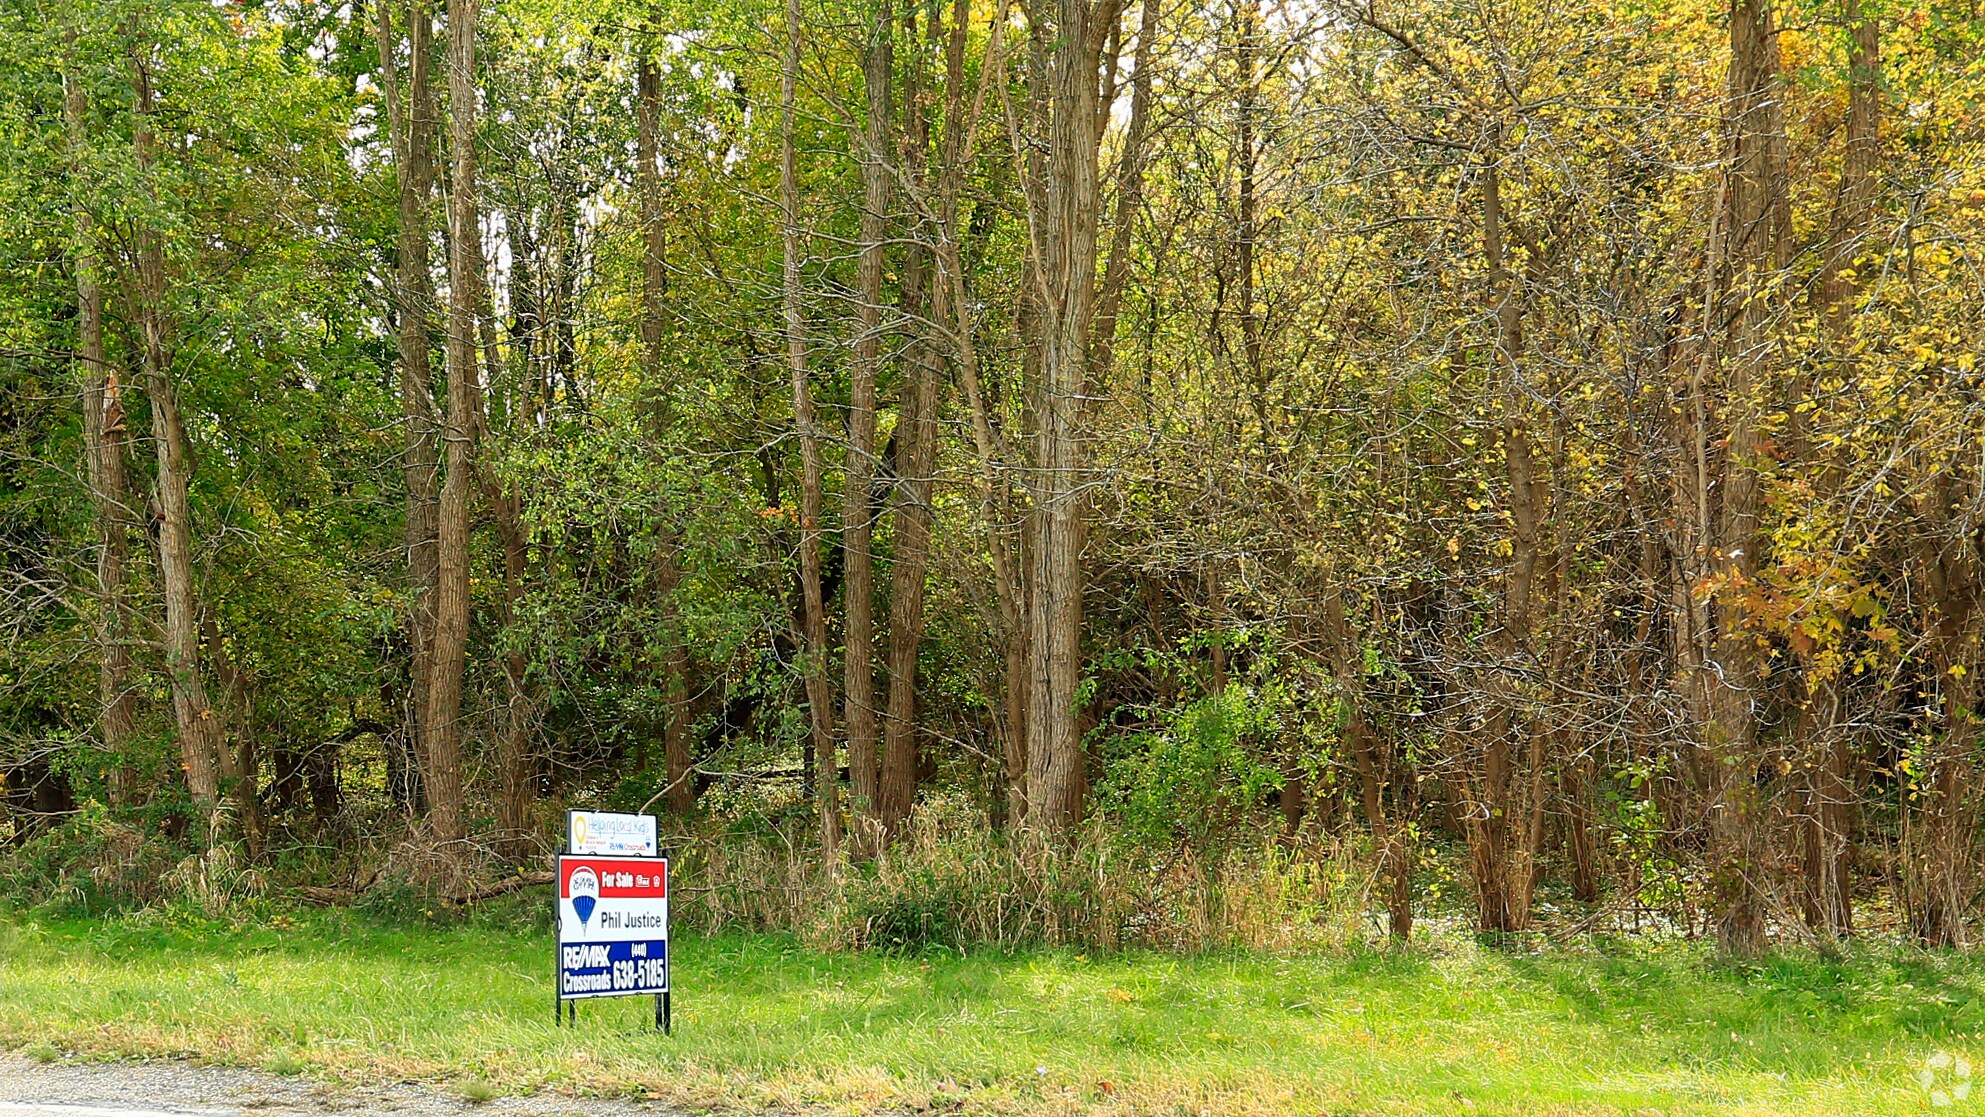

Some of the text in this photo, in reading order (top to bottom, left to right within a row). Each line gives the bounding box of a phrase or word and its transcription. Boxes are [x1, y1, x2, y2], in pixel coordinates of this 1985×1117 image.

[588, 817, 650, 839] Helping Local Kids
[601, 871, 615, 887] For
[615, 871, 634, 888] Sale
[601, 911, 661, 928] Phil Justice
[563, 944, 611, 970] RE/MAX
[563, 969, 611, 992] Crossroads
[613, 959, 665, 990] 638-5185
